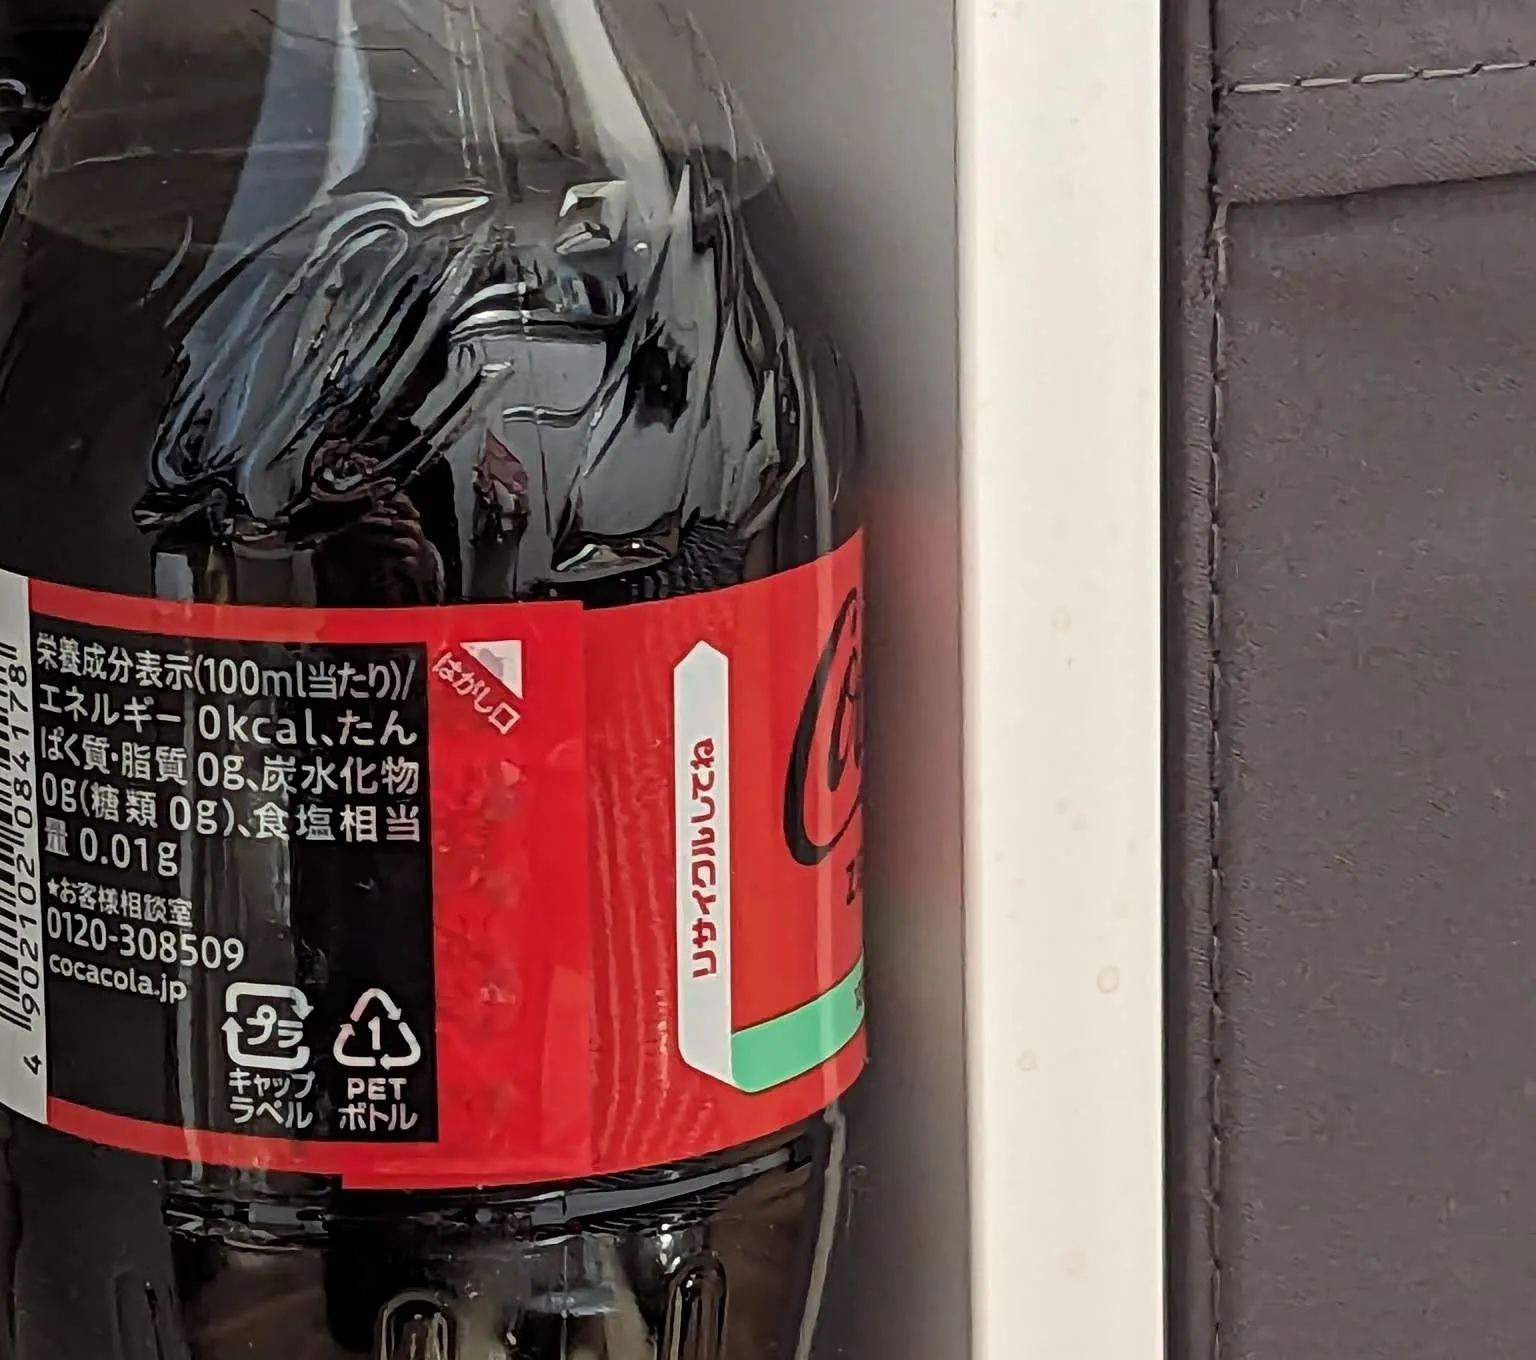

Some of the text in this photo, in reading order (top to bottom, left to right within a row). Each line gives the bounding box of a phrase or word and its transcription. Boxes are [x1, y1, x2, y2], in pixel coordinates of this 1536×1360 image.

[39, 683, 182, 733] エネルギー
[433, 652, 520, 735] はがし口
[41, 726, 188, 786] ばく質・脂質
[7, 663, 42, 1077] 4 902102 084178
[79, 827, 179, 877] 0.01g
[690, 737, 717, 978] リサイクルしてね
[46, 906, 245, 972] 0120-308509
[48, 953, 188, 1004] cocacola.jp
[246, 1004, 304, 1048] プラ
[367, 1016, 382, 1051] 1
[228, 1068, 317, 1100] キャップ
[347, 1077, 408, 1101] PET
[230, 1096, 314, 1130] ラベル
[338, 1102, 419, 1132] ボトル
